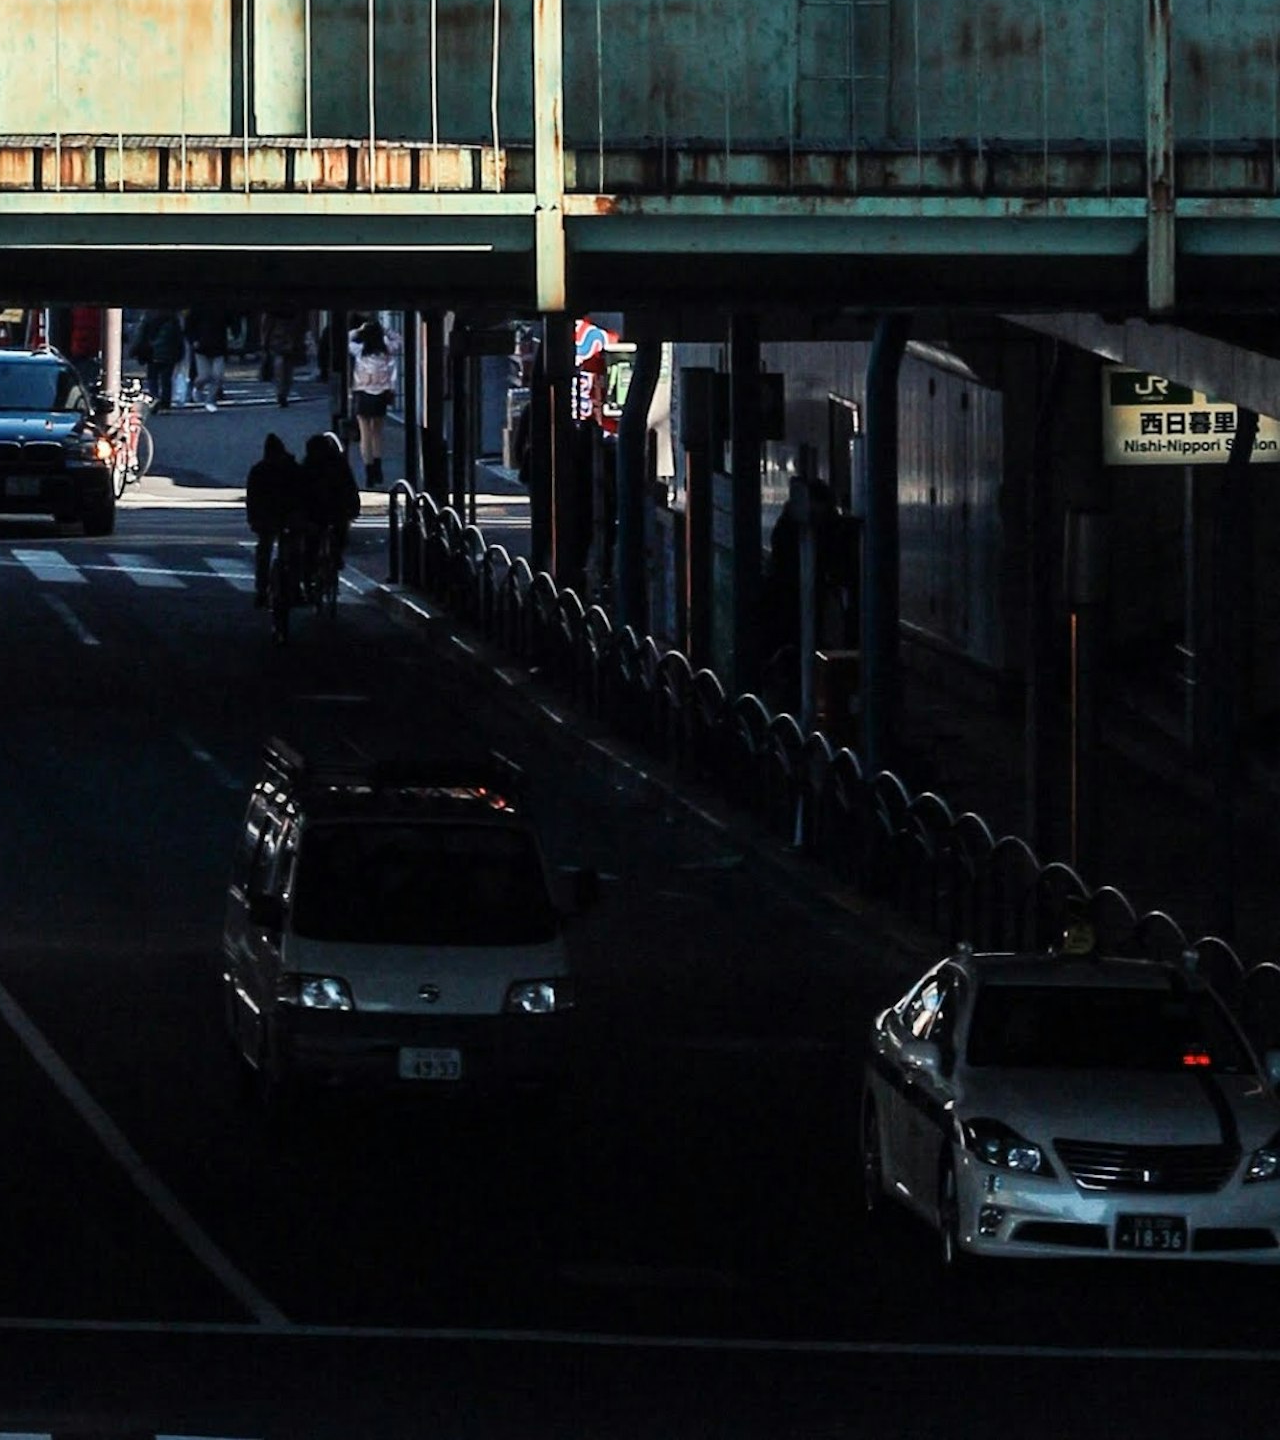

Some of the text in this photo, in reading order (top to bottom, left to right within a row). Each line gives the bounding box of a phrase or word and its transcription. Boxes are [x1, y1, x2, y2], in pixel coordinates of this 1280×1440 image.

[1135, 375, 1169, 395] JR
[1141, 411, 1238, 435] 西日暮里
[1124, 438, 1221, 455] Nishi-Nippori
